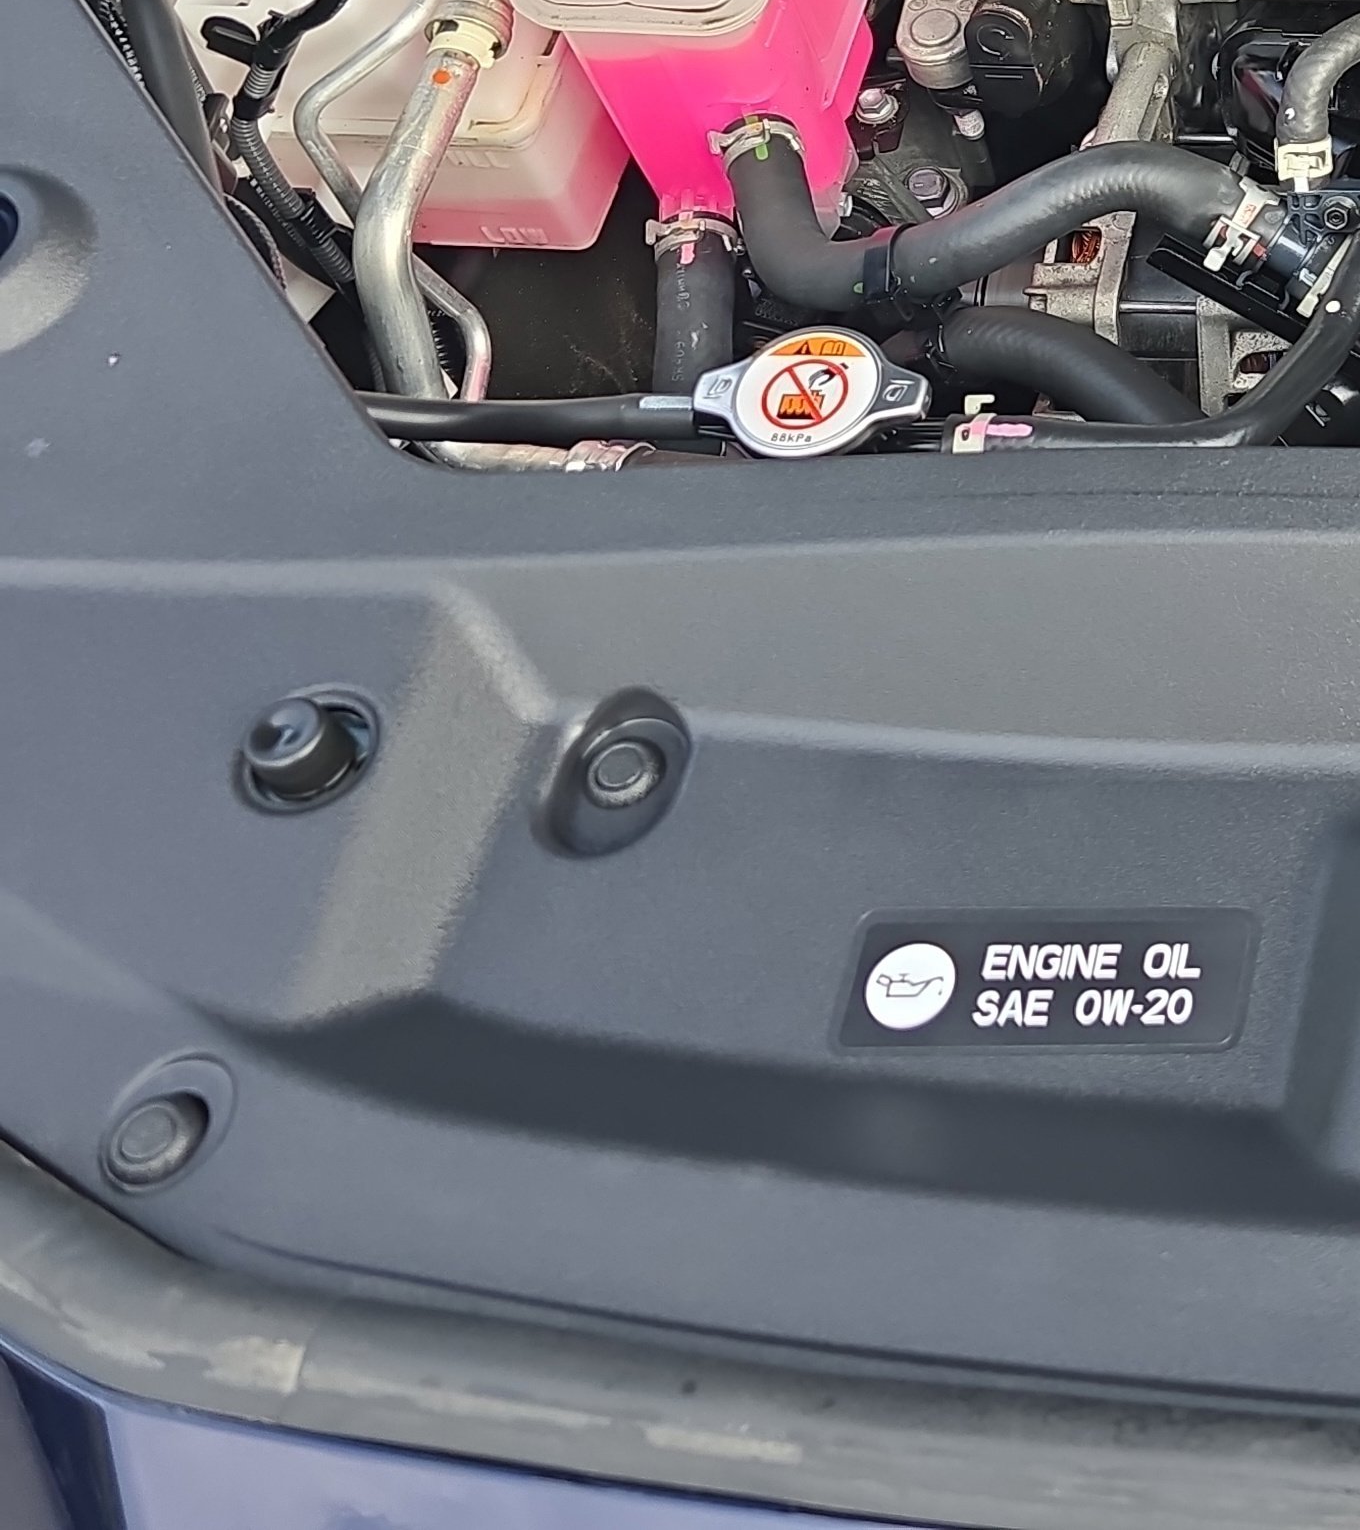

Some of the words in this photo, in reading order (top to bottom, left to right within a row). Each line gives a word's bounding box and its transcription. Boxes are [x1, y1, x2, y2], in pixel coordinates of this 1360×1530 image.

[480, 225, 550, 245] LOW
[770, 432, 813, 443] 88kPa
[980, 941, 1124, 981] ENGINE
[1142, 942, 1202, 980] OIL
[971, 987, 1055, 1028] SAE
[1073, 987, 1194, 1028] 0W-20
